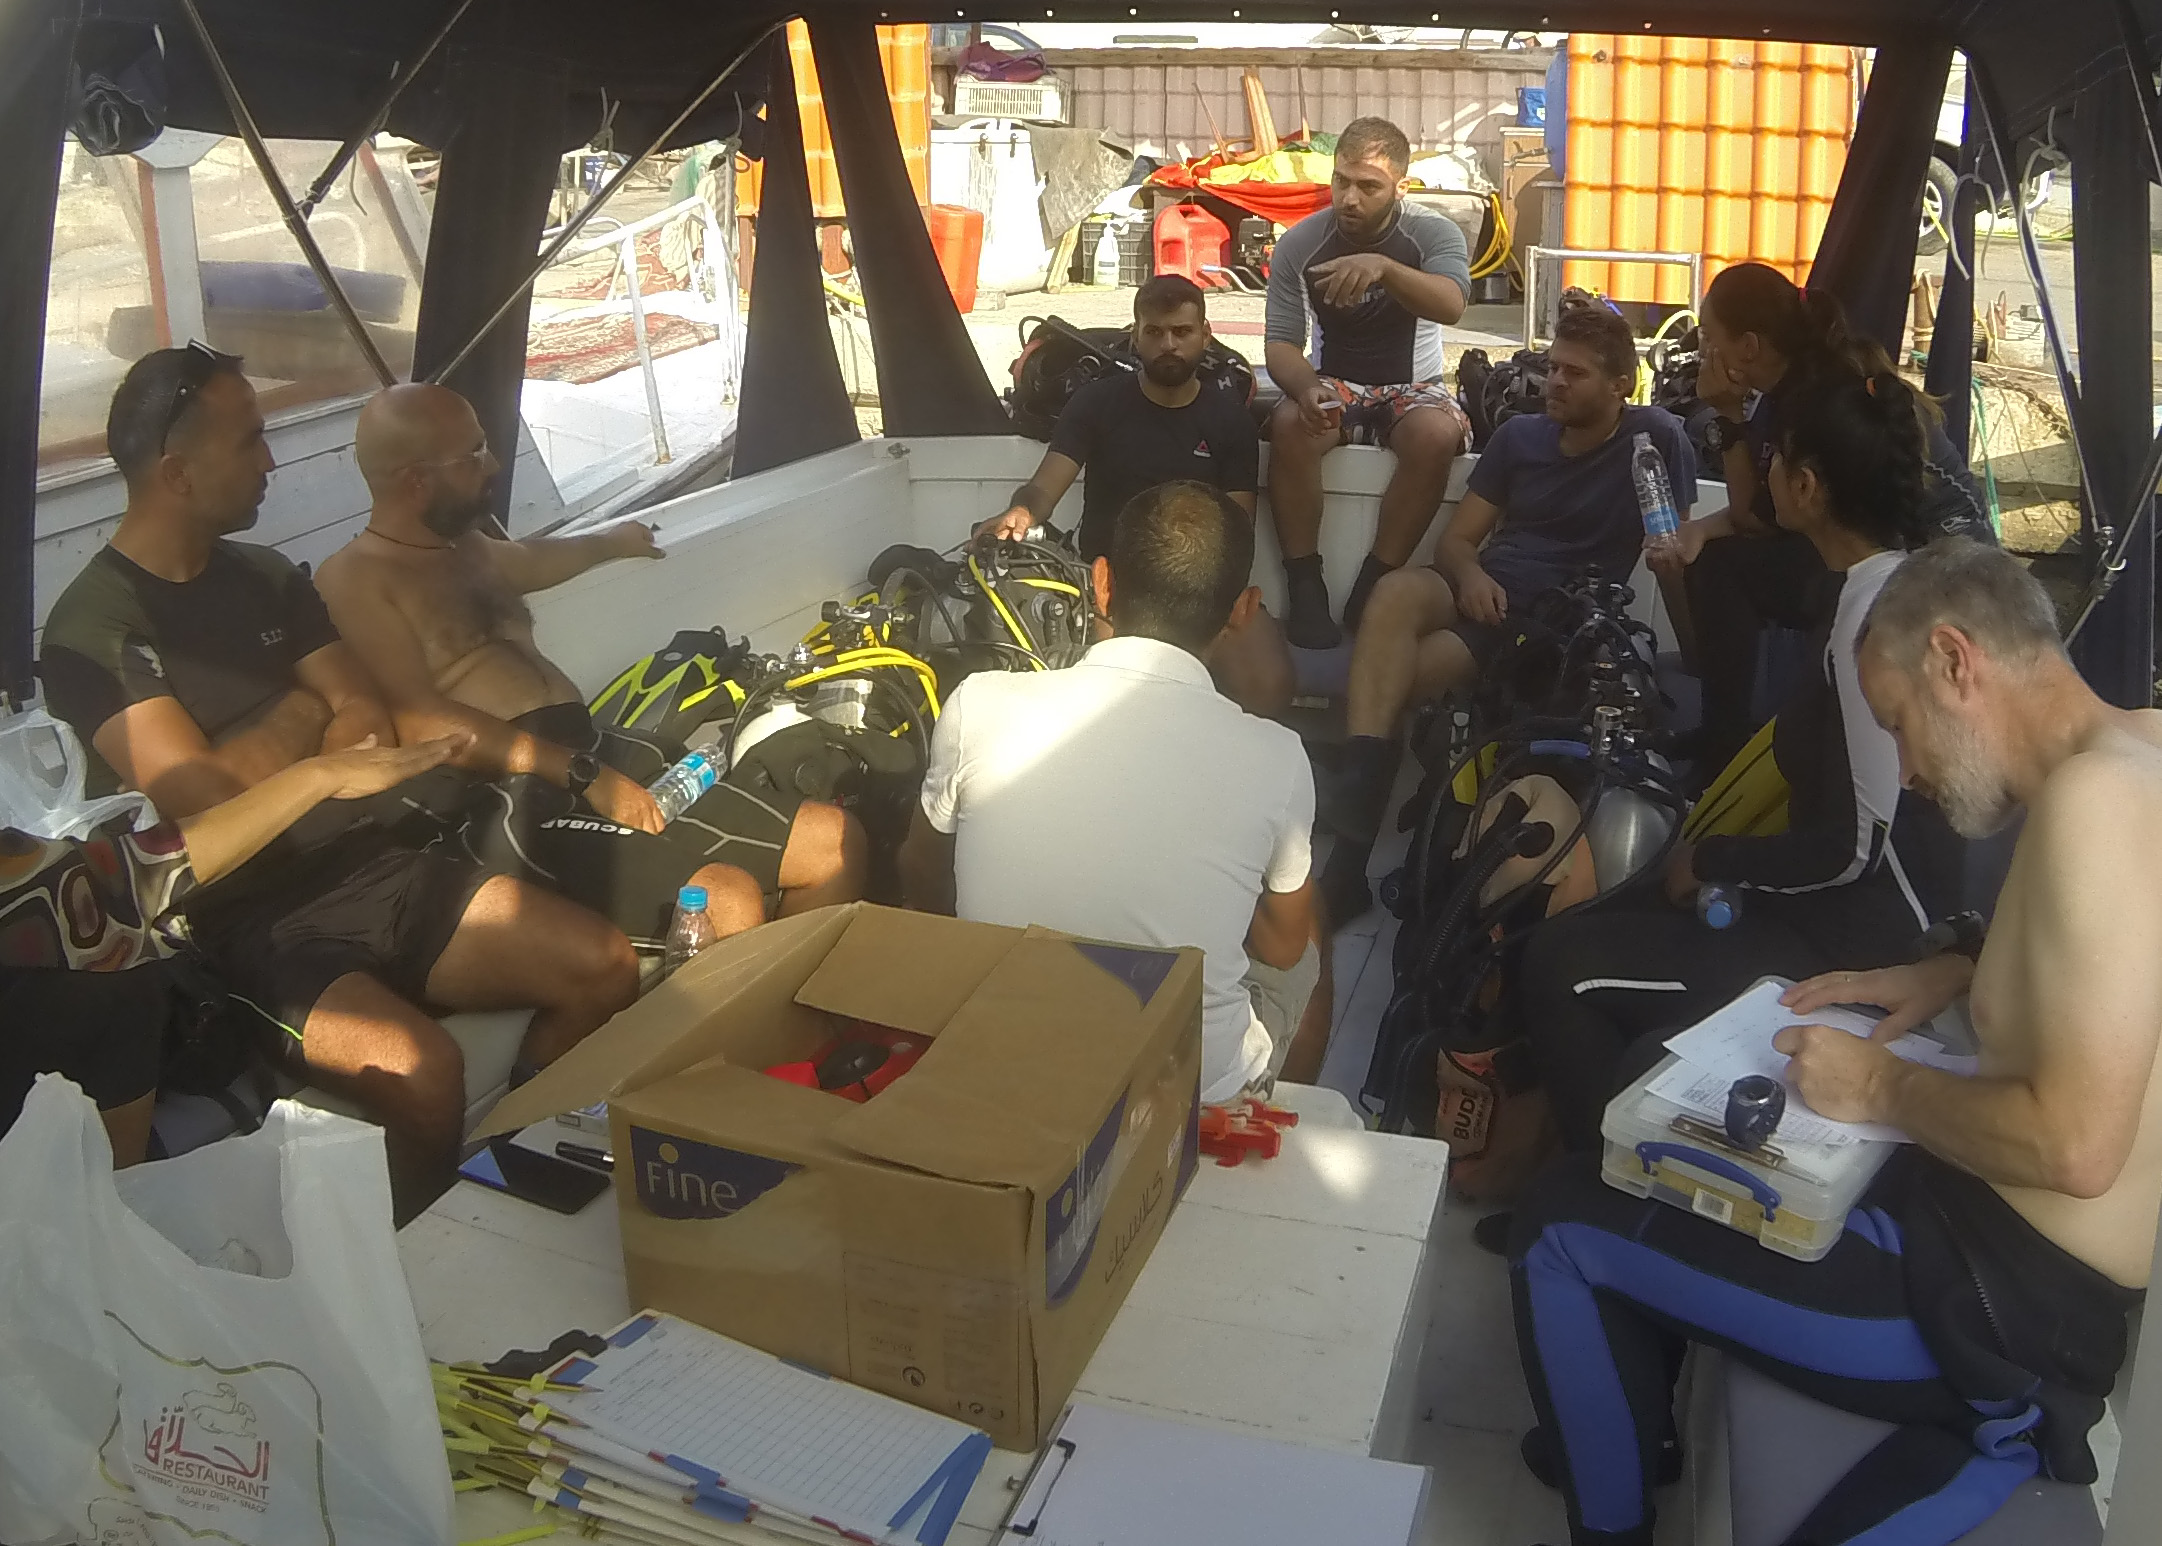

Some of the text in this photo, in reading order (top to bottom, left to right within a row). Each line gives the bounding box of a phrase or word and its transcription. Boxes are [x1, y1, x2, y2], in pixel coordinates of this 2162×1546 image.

[646, 1142, 738, 1214] Fine
[163, 1458, 270, 1500] RESTAURANT
[182, 1485, 208, 1498] DAILY
